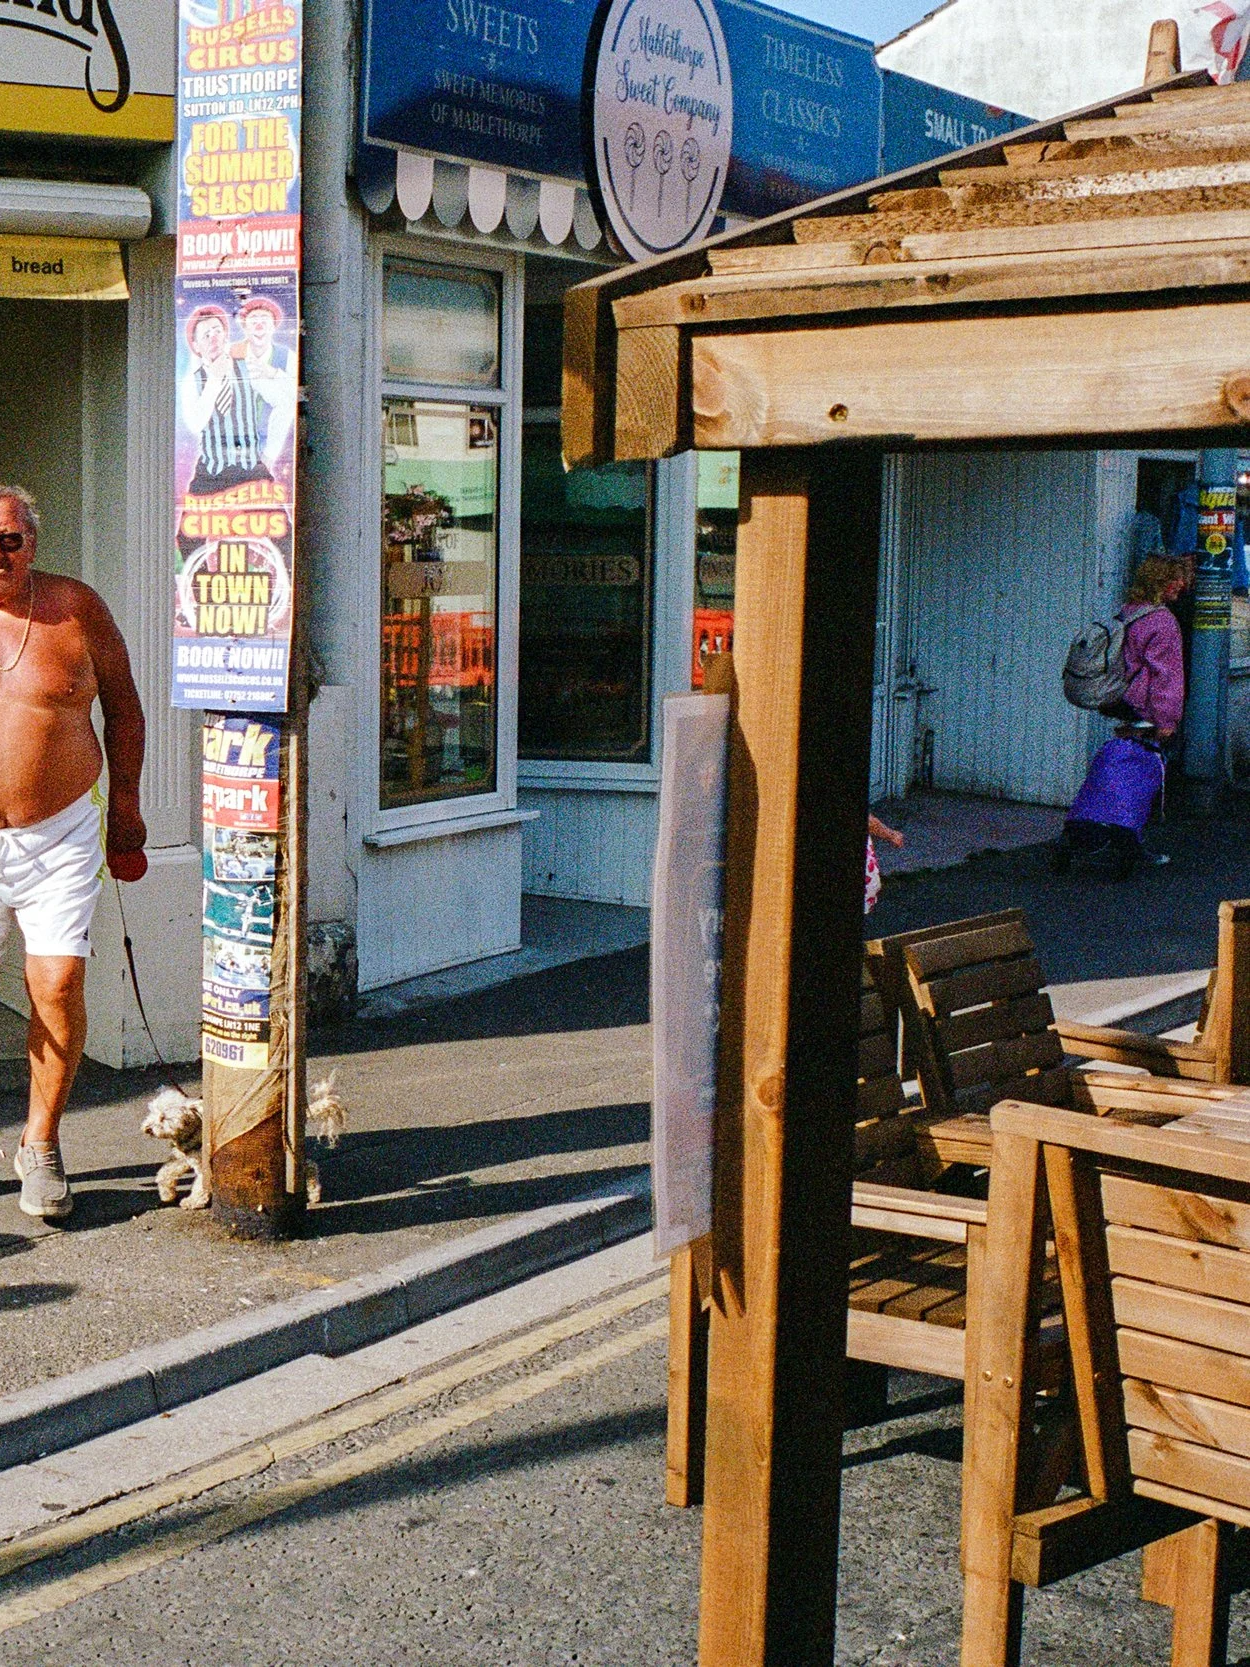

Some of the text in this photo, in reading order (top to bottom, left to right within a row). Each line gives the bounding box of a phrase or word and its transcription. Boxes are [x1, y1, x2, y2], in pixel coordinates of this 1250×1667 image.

[189, 6, 296, 46] RUSSELLS
[446, 0, 538, 54] SWEETS
[188, 39, 296, 70] CIRCUS
[762, 34, 844, 89] TIMELESS
[183, 68, 298, 98] TRUSTHORPE
[616, 59, 721, 137] Sweet Company
[183, 102, 226, 117] SUTTON
[249, 97, 274, 112] LN12
[277, 94, 298, 109] 2PH
[431, 102, 449, 124] OF
[762, 88, 841, 138] CLASSICS
[192, 117, 289, 152] FOR THE
[924, 108, 967, 148] SMALL
[185, 149, 293, 185] SUMMER
[191, 182, 287, 216] SEASON
[182, 229, 295, 257] BOOK NOW!!
[11, 255, 65, 276] bread
[184, 483, 286, 511] RUSSELLS
[182, 511, 288, 537] CIRCUS
[219, 543, 246, 573] IN
[196, 573, 270, 604] TOWN
[198, 605, 267, 635] NOW!
[177, 645, 285, 671] BOOK NOW!!
[203, 724, 274, 767] ark
[213, 984, 241, 998] ONLY
[244, 1022, 261, 1031] 1NE
[205, 1037, 245, 1061] 620961
